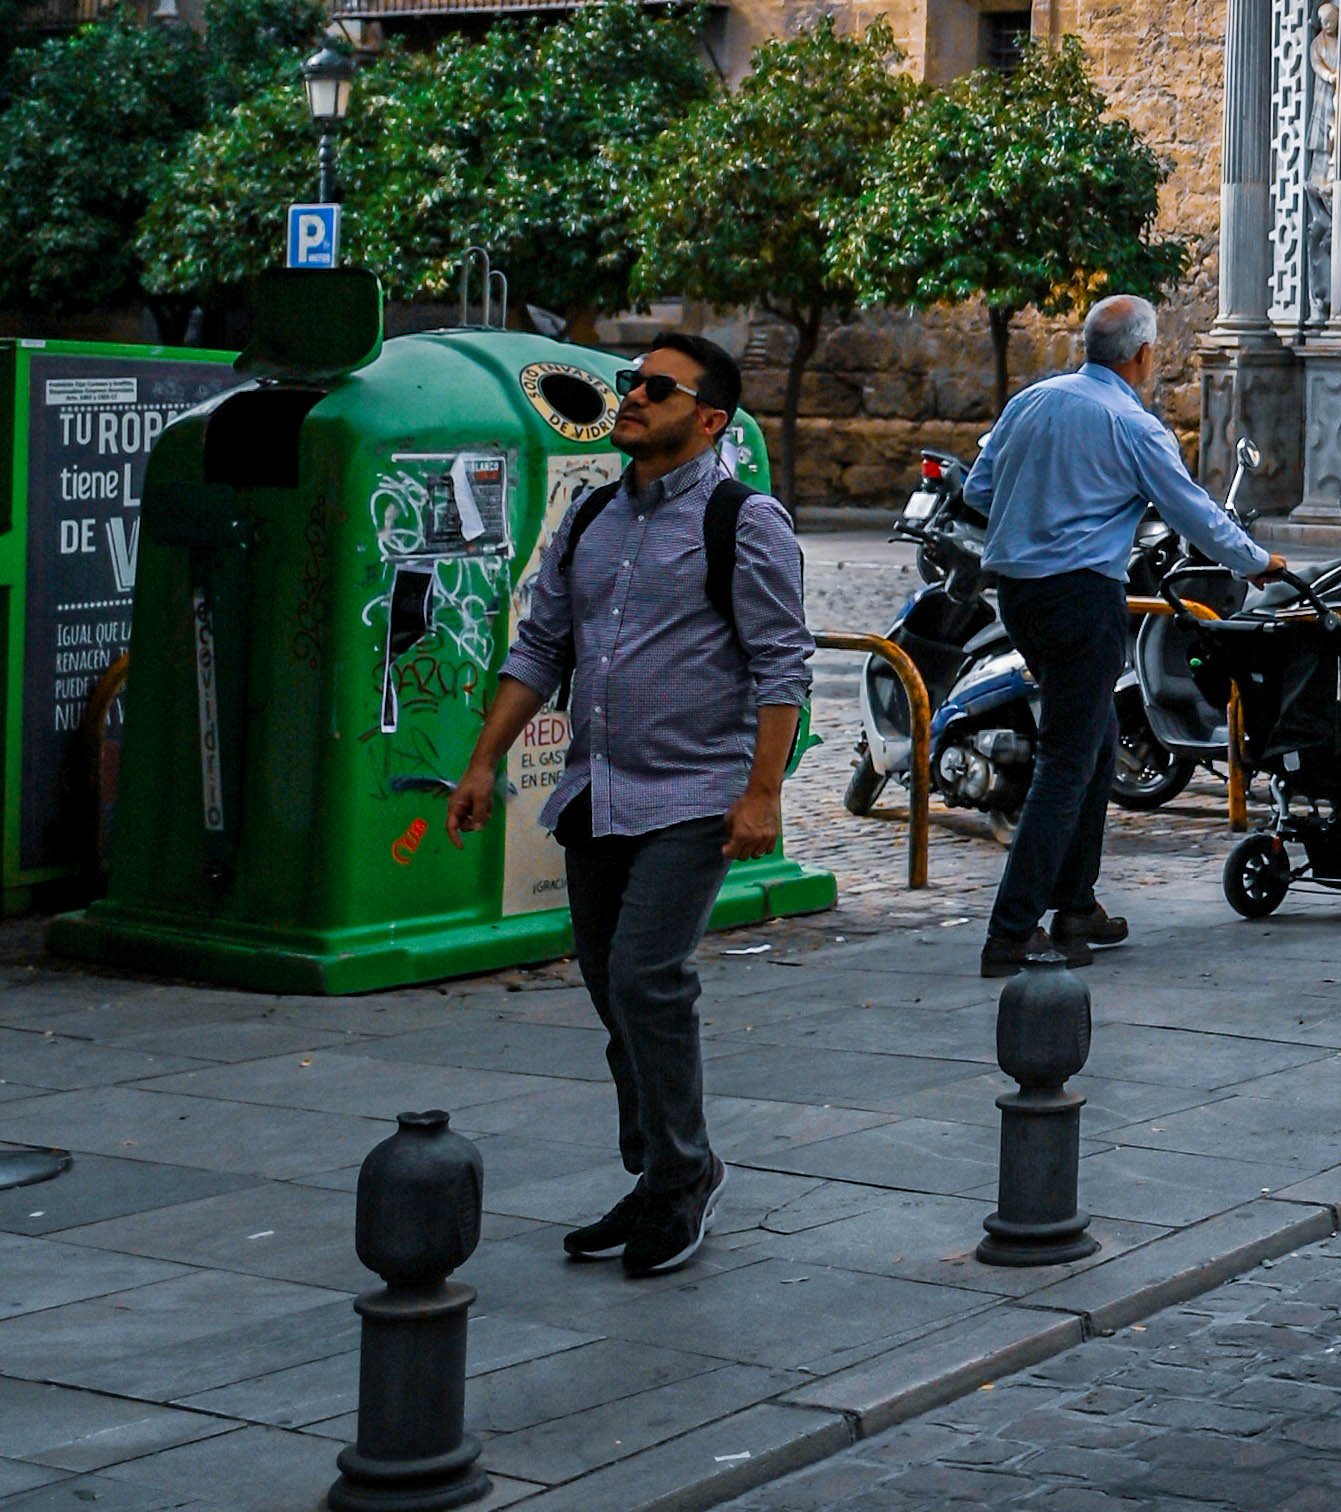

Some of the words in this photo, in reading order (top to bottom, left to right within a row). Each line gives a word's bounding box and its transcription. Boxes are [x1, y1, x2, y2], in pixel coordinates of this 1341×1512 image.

[298, 215, 326, 264] P
[523, 369, 540, 399] SOLO
[539, 364, 609, 395] ENVASES
[60, 413, 92, 446] TU
[549, 414, 569, 434] DE
[574, 407, 618, 439] VIDRIO
[60, 465, 119, 501] tiene
[60, 519, 96, 554] DE
[57, 623, 92, 647] IGUAL
[95, 622, 118, 648] QUE
[55, 677, 89, 700] PUEDE
[521, 753, 536, 768] EL
[521, 774, 537, 789] EN
[540, 770, 563, 786] ENE
